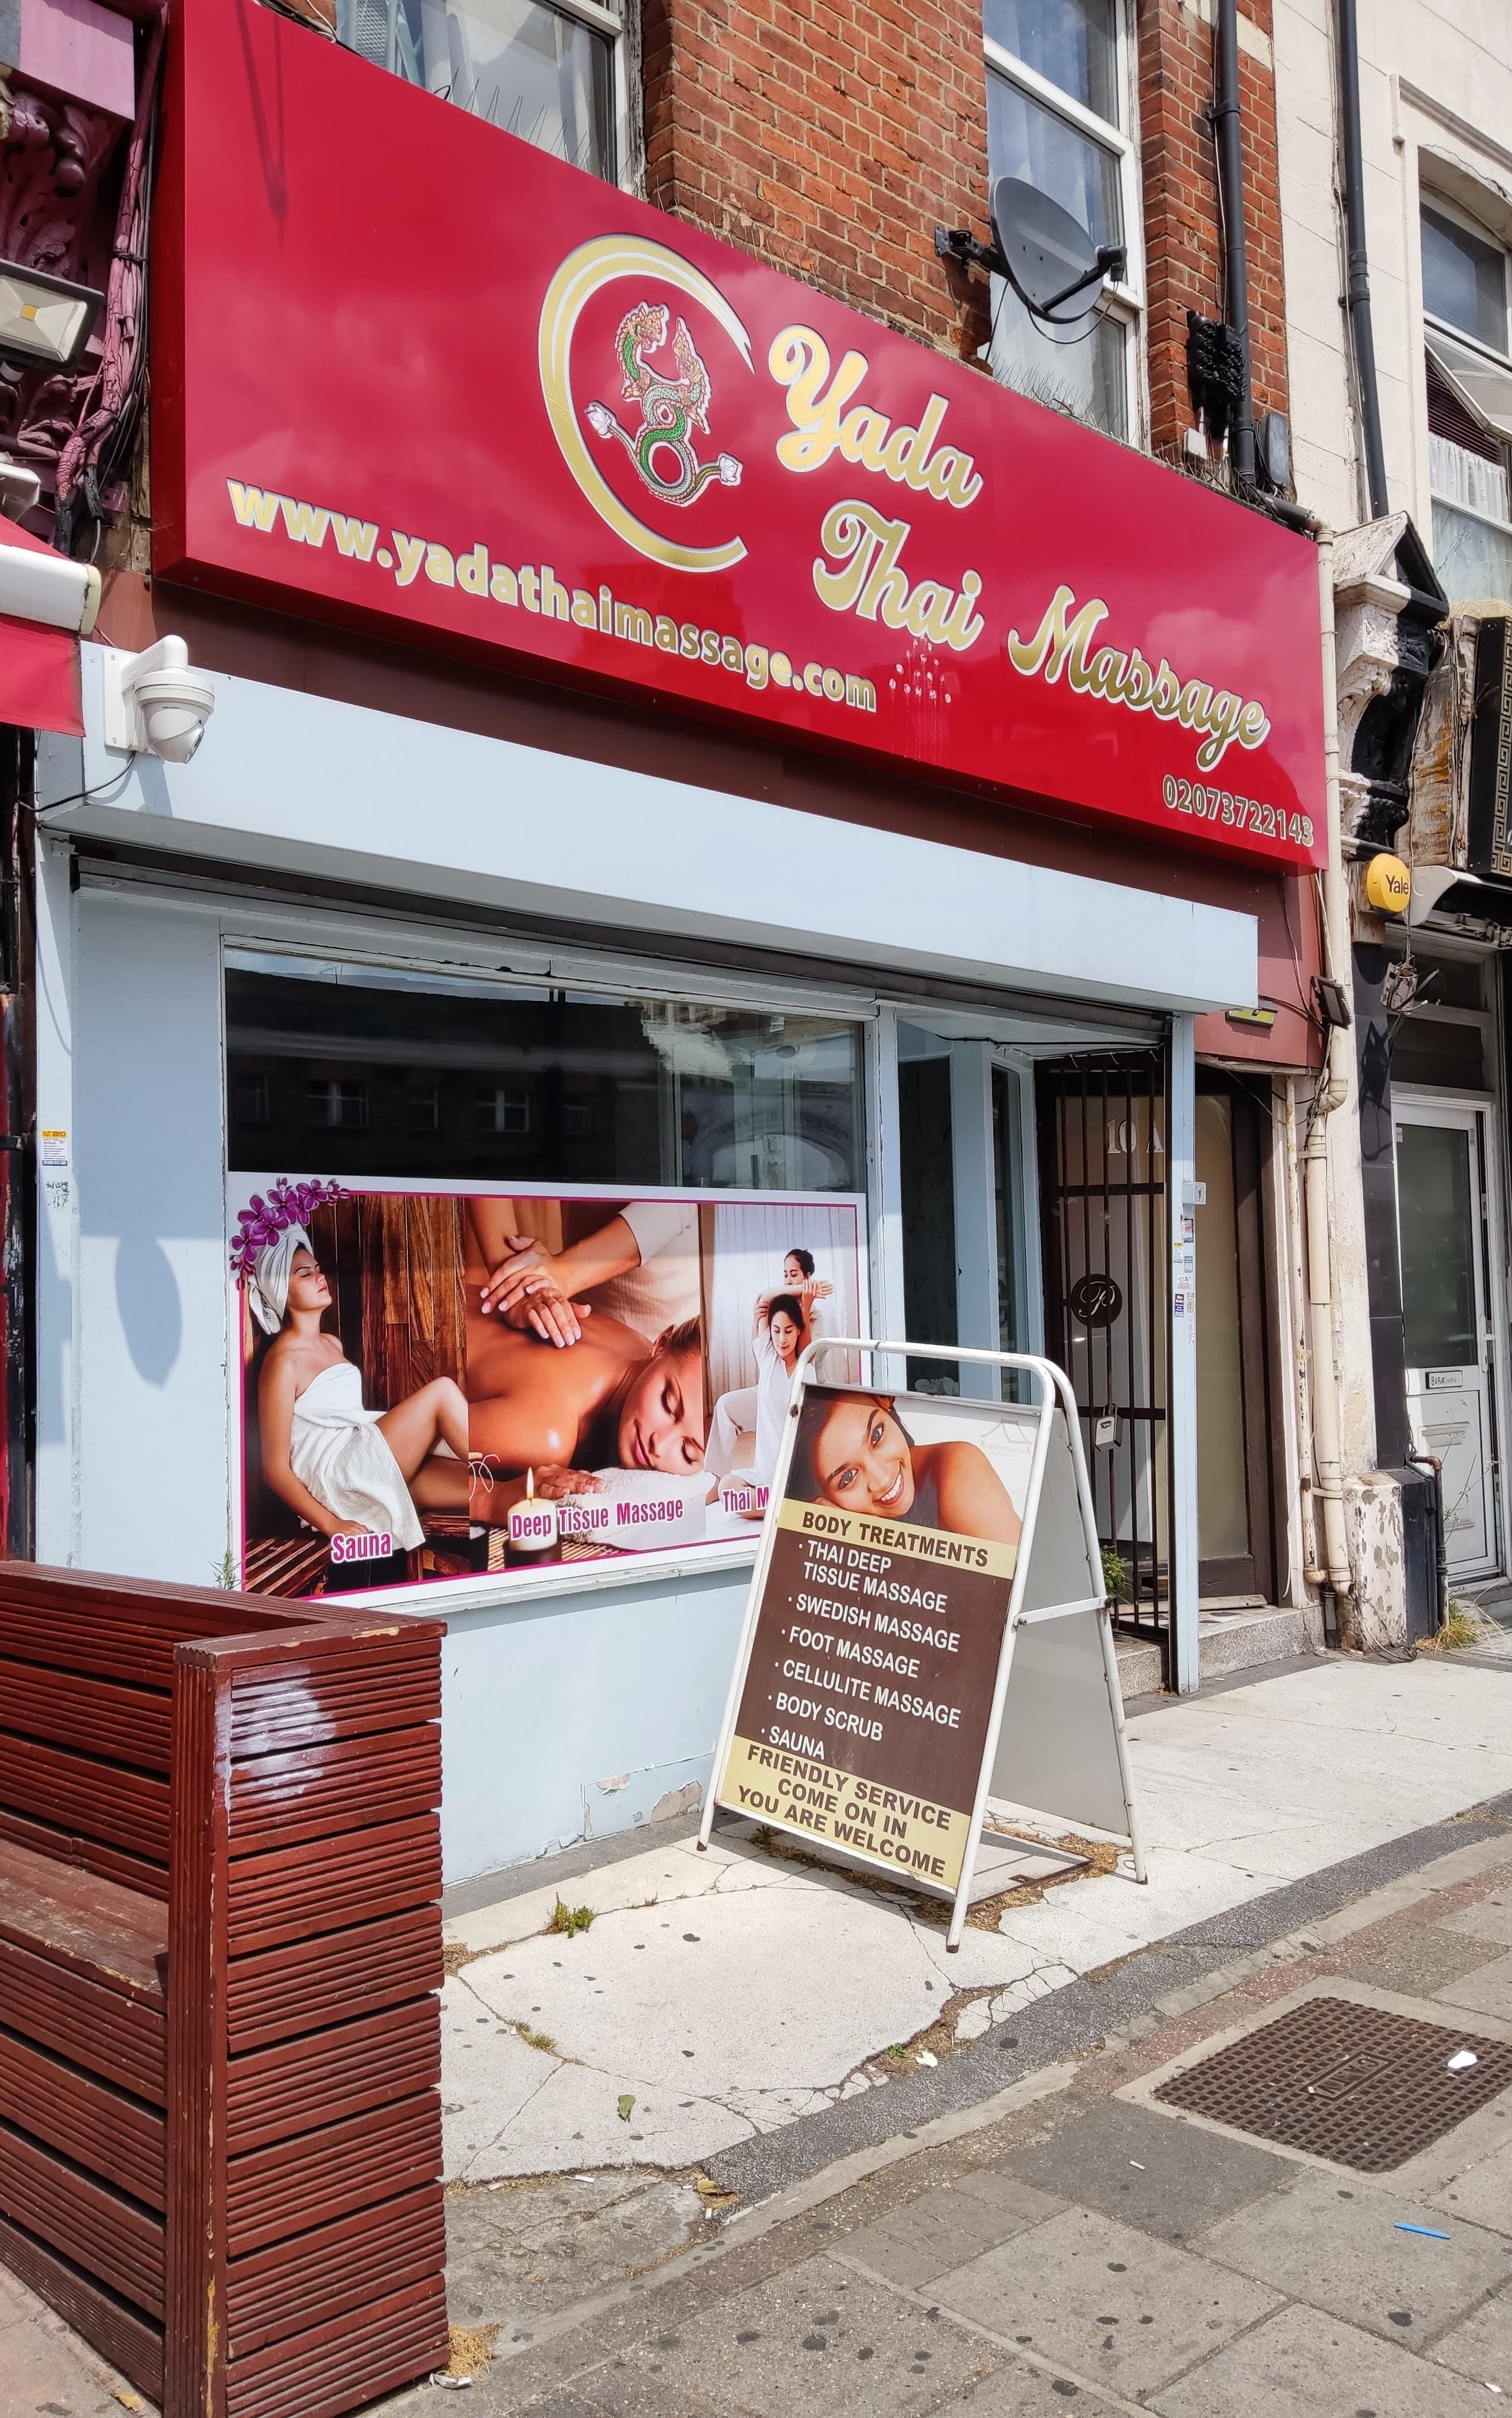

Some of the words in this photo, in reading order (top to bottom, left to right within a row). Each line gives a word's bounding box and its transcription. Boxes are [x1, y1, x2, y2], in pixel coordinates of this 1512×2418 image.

[768, 324, 983, 509] Yada
[226, 477, 877, 713] www.yadathaimassage.com
[812, 498, 985, 651] Thai
[1008, 584, 1271, 772] Massage
[1162, 774, 1314, 847] 02073722143
[1385, 875, 1409, 895] Yale
[511, 1513, 553, 1539] Deep
[559, 1507, 609, 1534] Tissue
[616, 1499, 684, 1526] Massage
[722, 1487, 751, 1513] Thai
[331, 1532, 392, 1562] Sauna
[803, 1511, 851, 1536] BODY
[859, 1523, 989, 1567] TREATMENTS
[808, 1539, 844, 1564] THAI
[847, 1550, 892, 1574] DEEP
[804, 1561, 860, 1591] TISSUE
[863, 1577, 947, 1614] MASSAGE
[789, 1626, 835, 1653] FOOT
[836, 1638, 920, 1678] MASSAGE
[796, 1593, 870, 1628] SWEDISH
[874, 1614, 961, 1653] MASSAGE
[776, 1692, 823, 1721] BODY
[824, 1707, 884, 1742] SCRUB
[783, 1659, 872, 1701] CELLULITE
[874, 1685, 962, 1729] MASSAGE
[769, 1725, 825, 1761] SAUNA
[747, 1744, 849, 1792] FRIENDLY
[854, 1782, 951, 1831] SERVICE
[778, 1778, 838, 1814] COME
[844, 1803, 877, 1827] ON
[883, 1815, 908, 1839] IN
[738, 1785, 779, 1814] YOU
[784, 1805, 828, 1832] ARE
[834, 1820, 946, 1878] WELCOME
